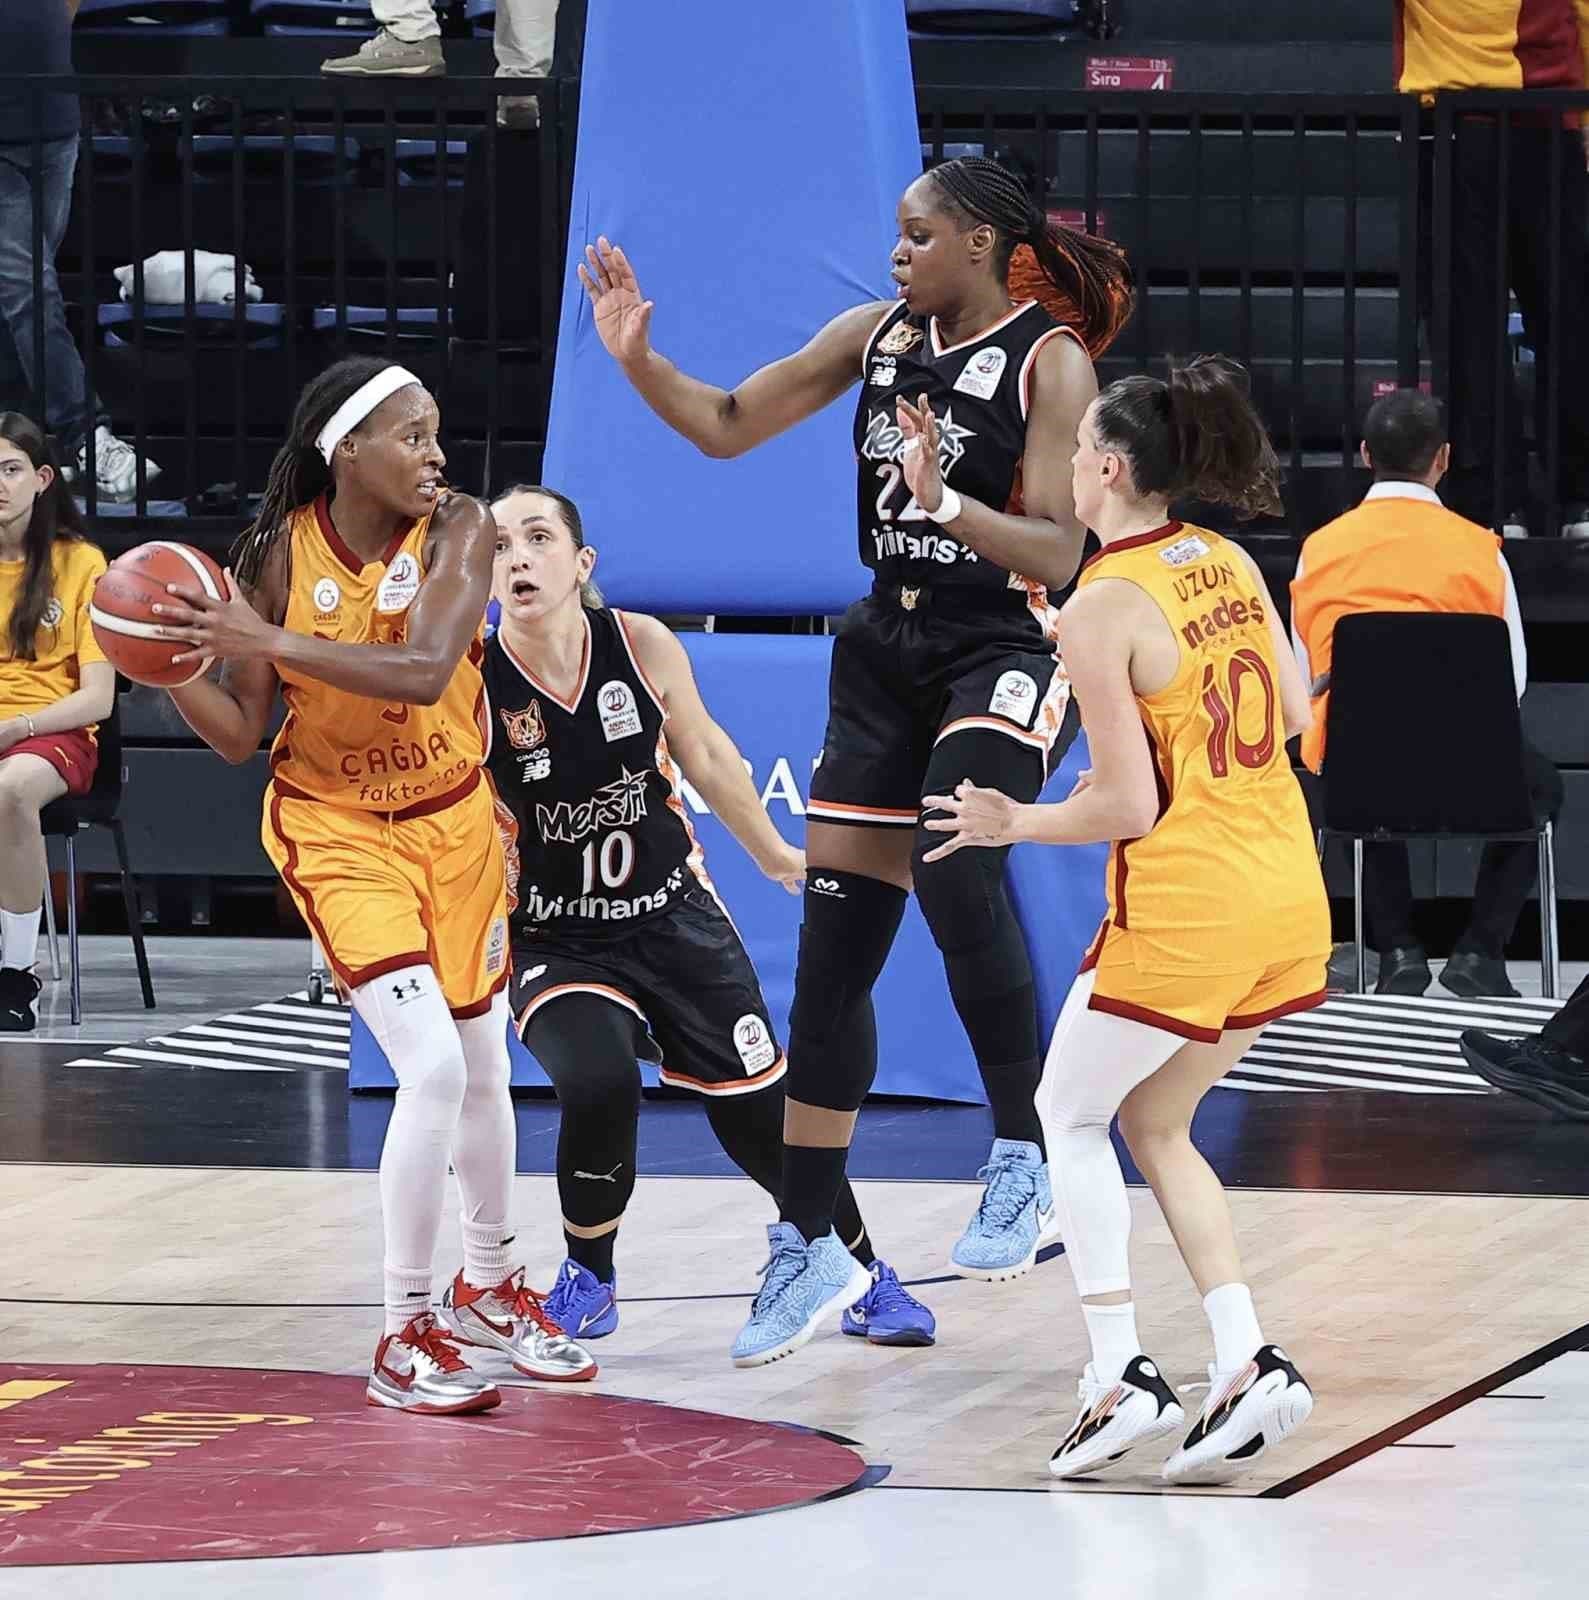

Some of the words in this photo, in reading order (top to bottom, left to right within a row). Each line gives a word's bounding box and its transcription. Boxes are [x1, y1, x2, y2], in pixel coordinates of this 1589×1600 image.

[1172, 561, 1237, 602] UZUN
[1201, 648, 1274, 779] 10
[340, 720, 454, 784] ÇAĞDA
[535, 766, 654, 844] Mersin
[581, 829, 635, 895] 10
[0, 1411, 315, 1524] toring
